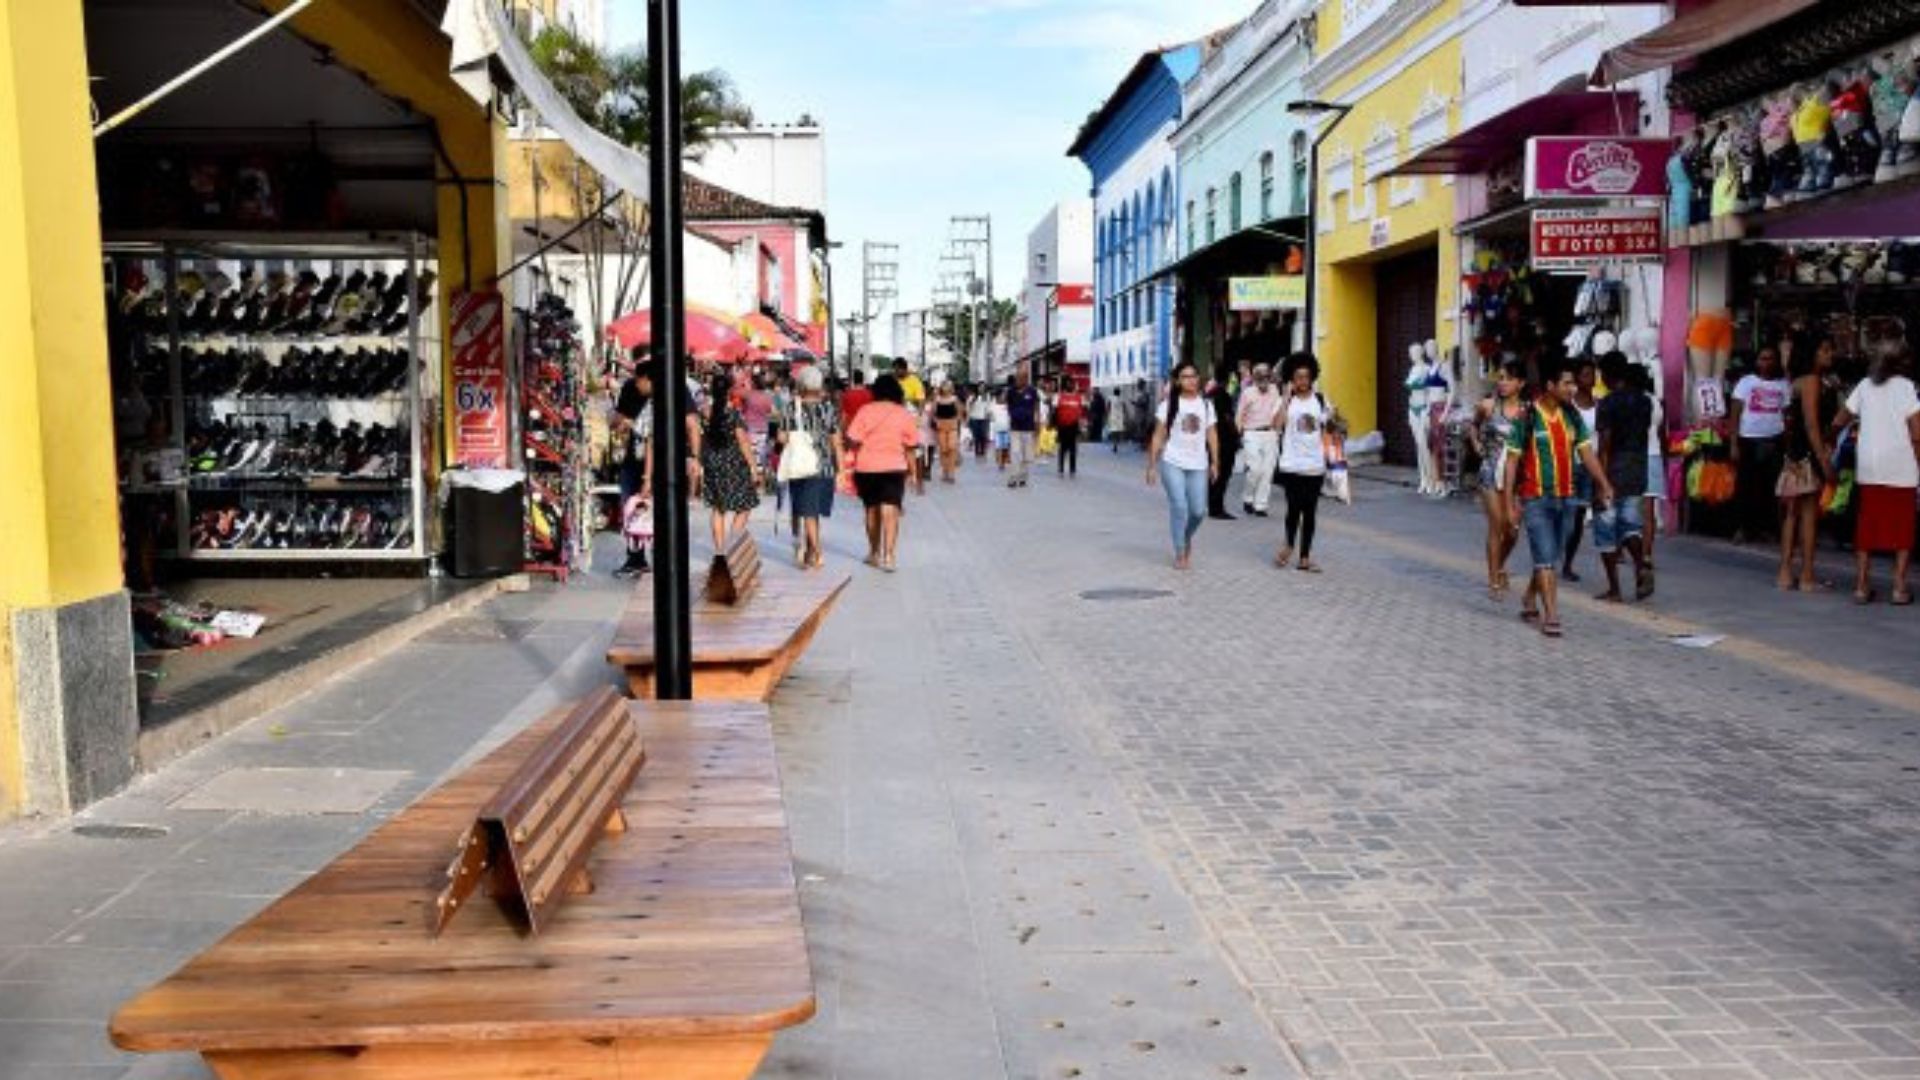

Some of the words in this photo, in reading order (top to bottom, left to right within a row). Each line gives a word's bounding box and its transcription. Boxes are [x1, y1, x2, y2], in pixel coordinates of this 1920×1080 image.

[1612, 221, 1656, 234] DIGITAL
[1541, 238, 1549, 252] E
[1559, 239, 1616, 252] FOTOS
